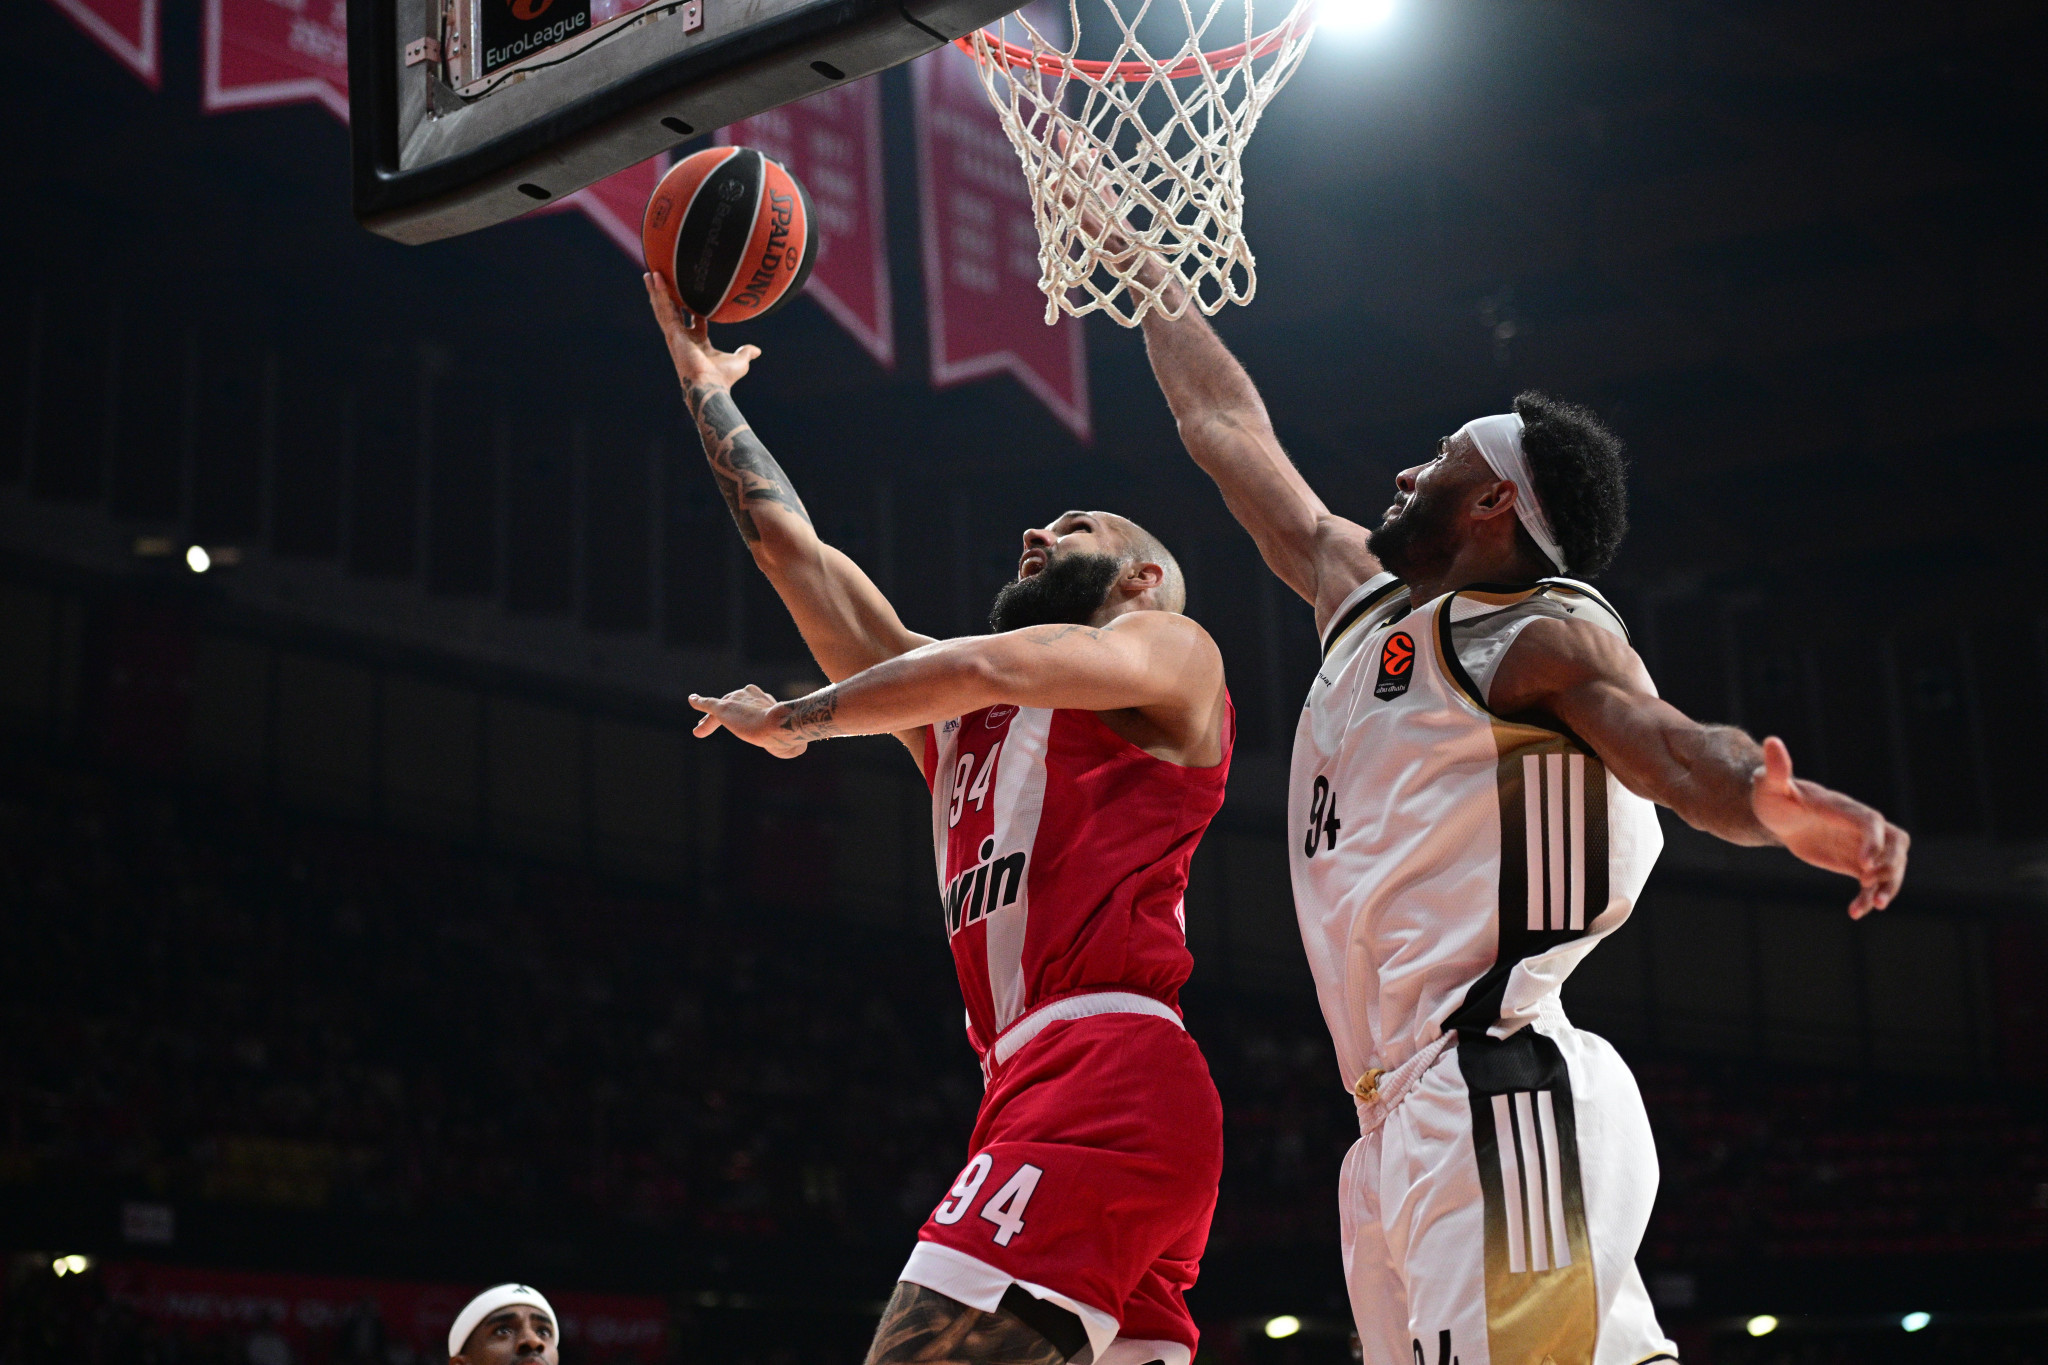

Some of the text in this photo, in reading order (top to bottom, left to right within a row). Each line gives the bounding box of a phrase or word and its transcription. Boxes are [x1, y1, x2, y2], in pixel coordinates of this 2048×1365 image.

[486, 11, 586, 68] EuroLeague
[732, 188, 794, 308] SPALDING
[950, 740, 1000, 828] 94
[1304, 775, 1341, 859] 94
[934, 1152, 1044, 1248] 94
